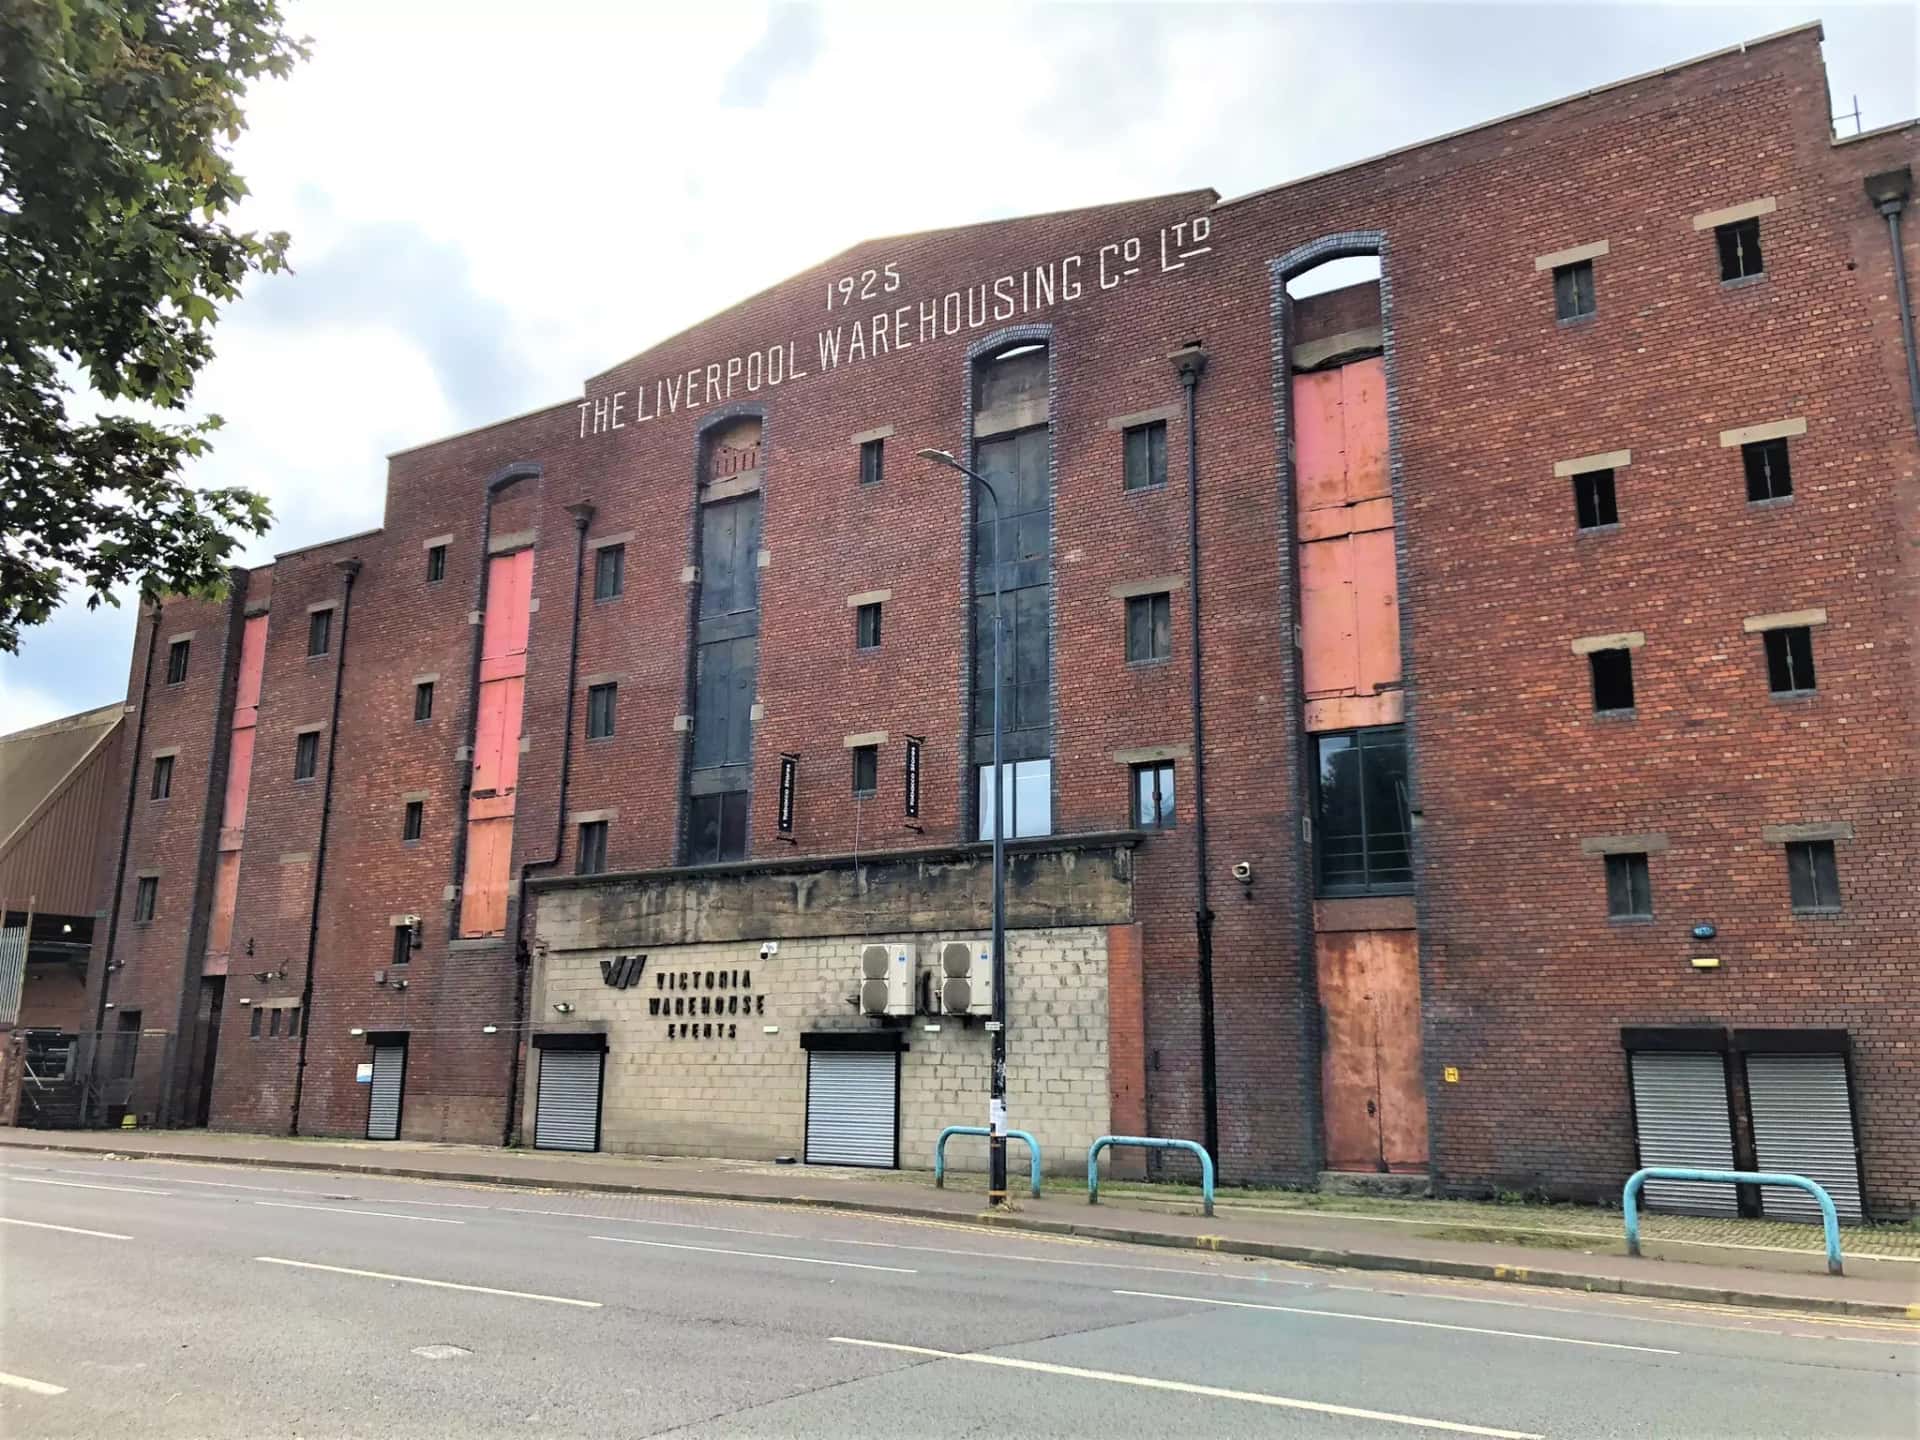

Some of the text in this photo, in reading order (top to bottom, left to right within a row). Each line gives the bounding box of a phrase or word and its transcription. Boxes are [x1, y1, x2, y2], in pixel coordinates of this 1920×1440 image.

[827, 263, 900, 311] 1925
[577, 391, 627, 438] THE
[637, 340, 808, 422] LIVERPOOL
[818, 255, 1082, 372] WAREHOUSING
[656, 970, 751, 990] VICTORIA
[649, 995, 765, 1017] WAREHOUSE
[668, 1023, 737, 1040] EVENTS
